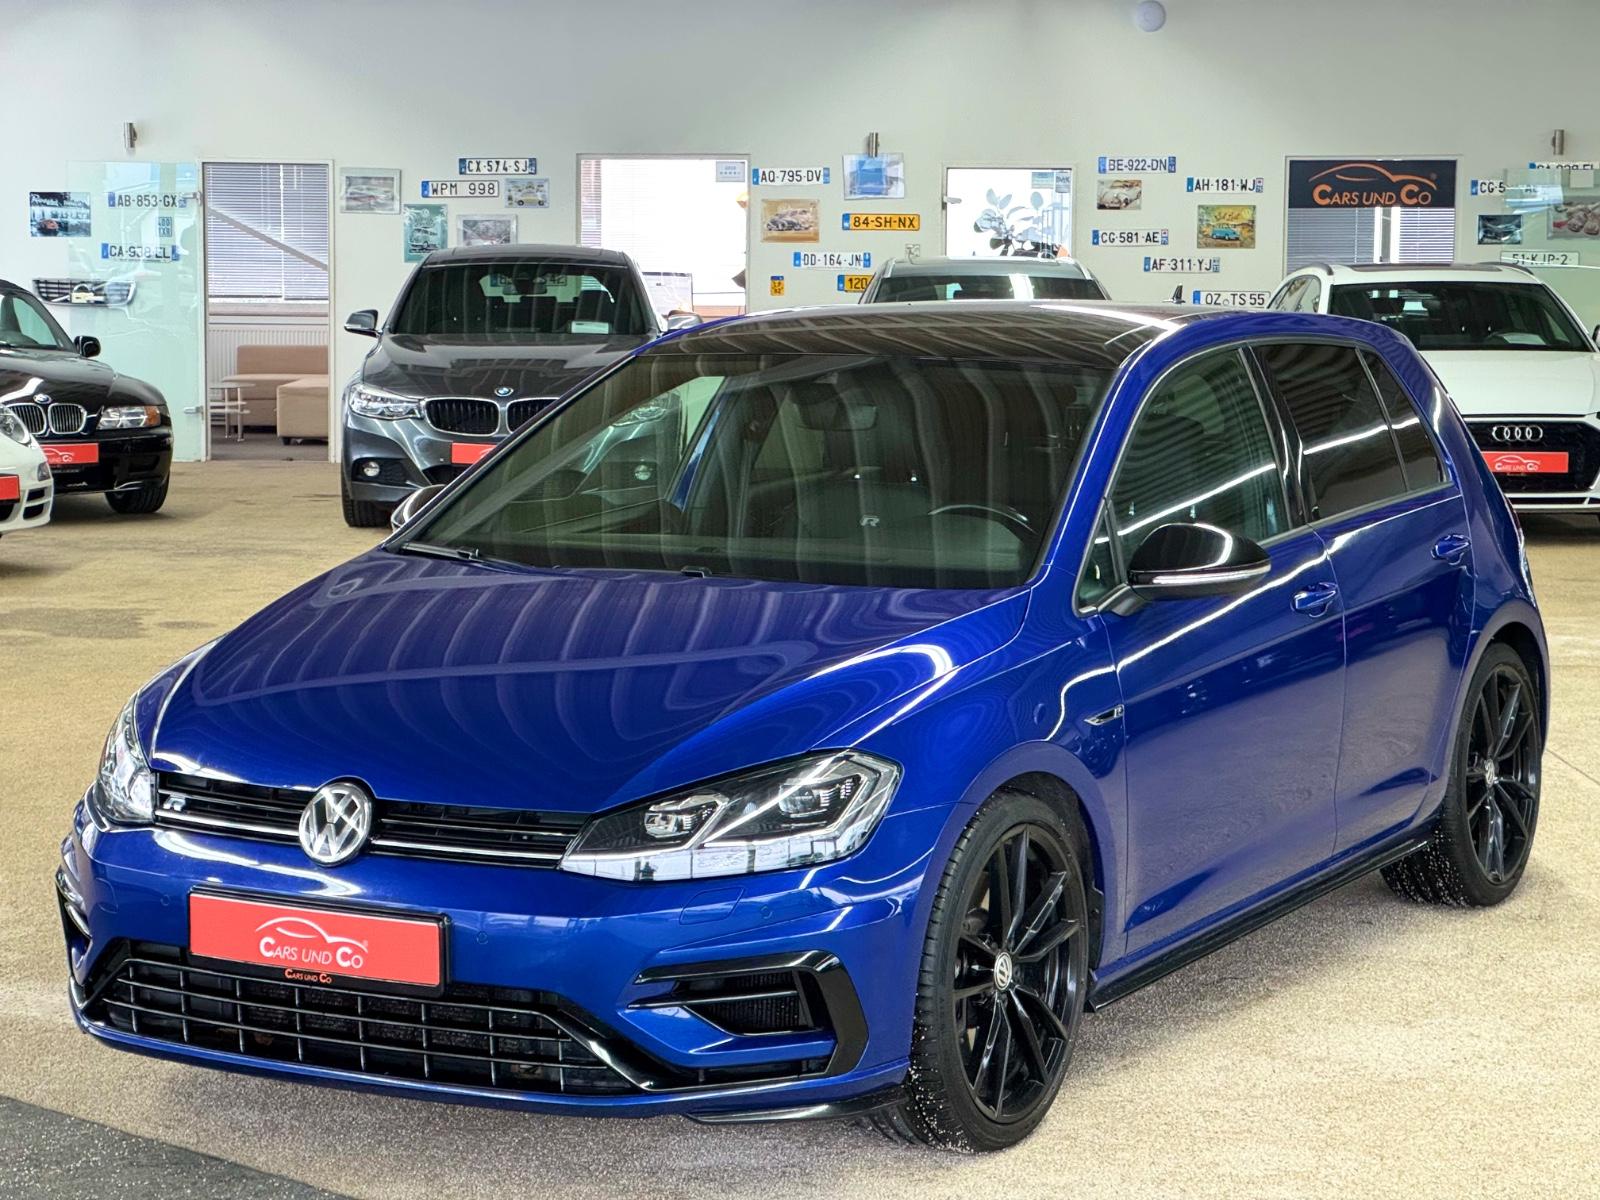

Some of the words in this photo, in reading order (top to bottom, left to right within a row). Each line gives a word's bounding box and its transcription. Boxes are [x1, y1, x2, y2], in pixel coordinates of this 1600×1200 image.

[467, 160, 528, 173] CX-574-SJ
[1108, 159, 1167, 171] BE-922-DN
[760, 169, 821, 183] AQ-795-DV
[431, 183, 458, 195] WPM
[468, 182, 495, 195] 998
[1194, 178, 1256, 192] AH-181-WJ
[117, 194, 177, 208] AB-853-GX
[1362, 191, 1396, 205] UND
[853, 215, 916, 228] 84-SH-NX
[1100, 230, 1159, 244] CG-581-AE
[1151, 258, 1212, 272] AF-311-YJ
[301, 948, 332, 965] UND
